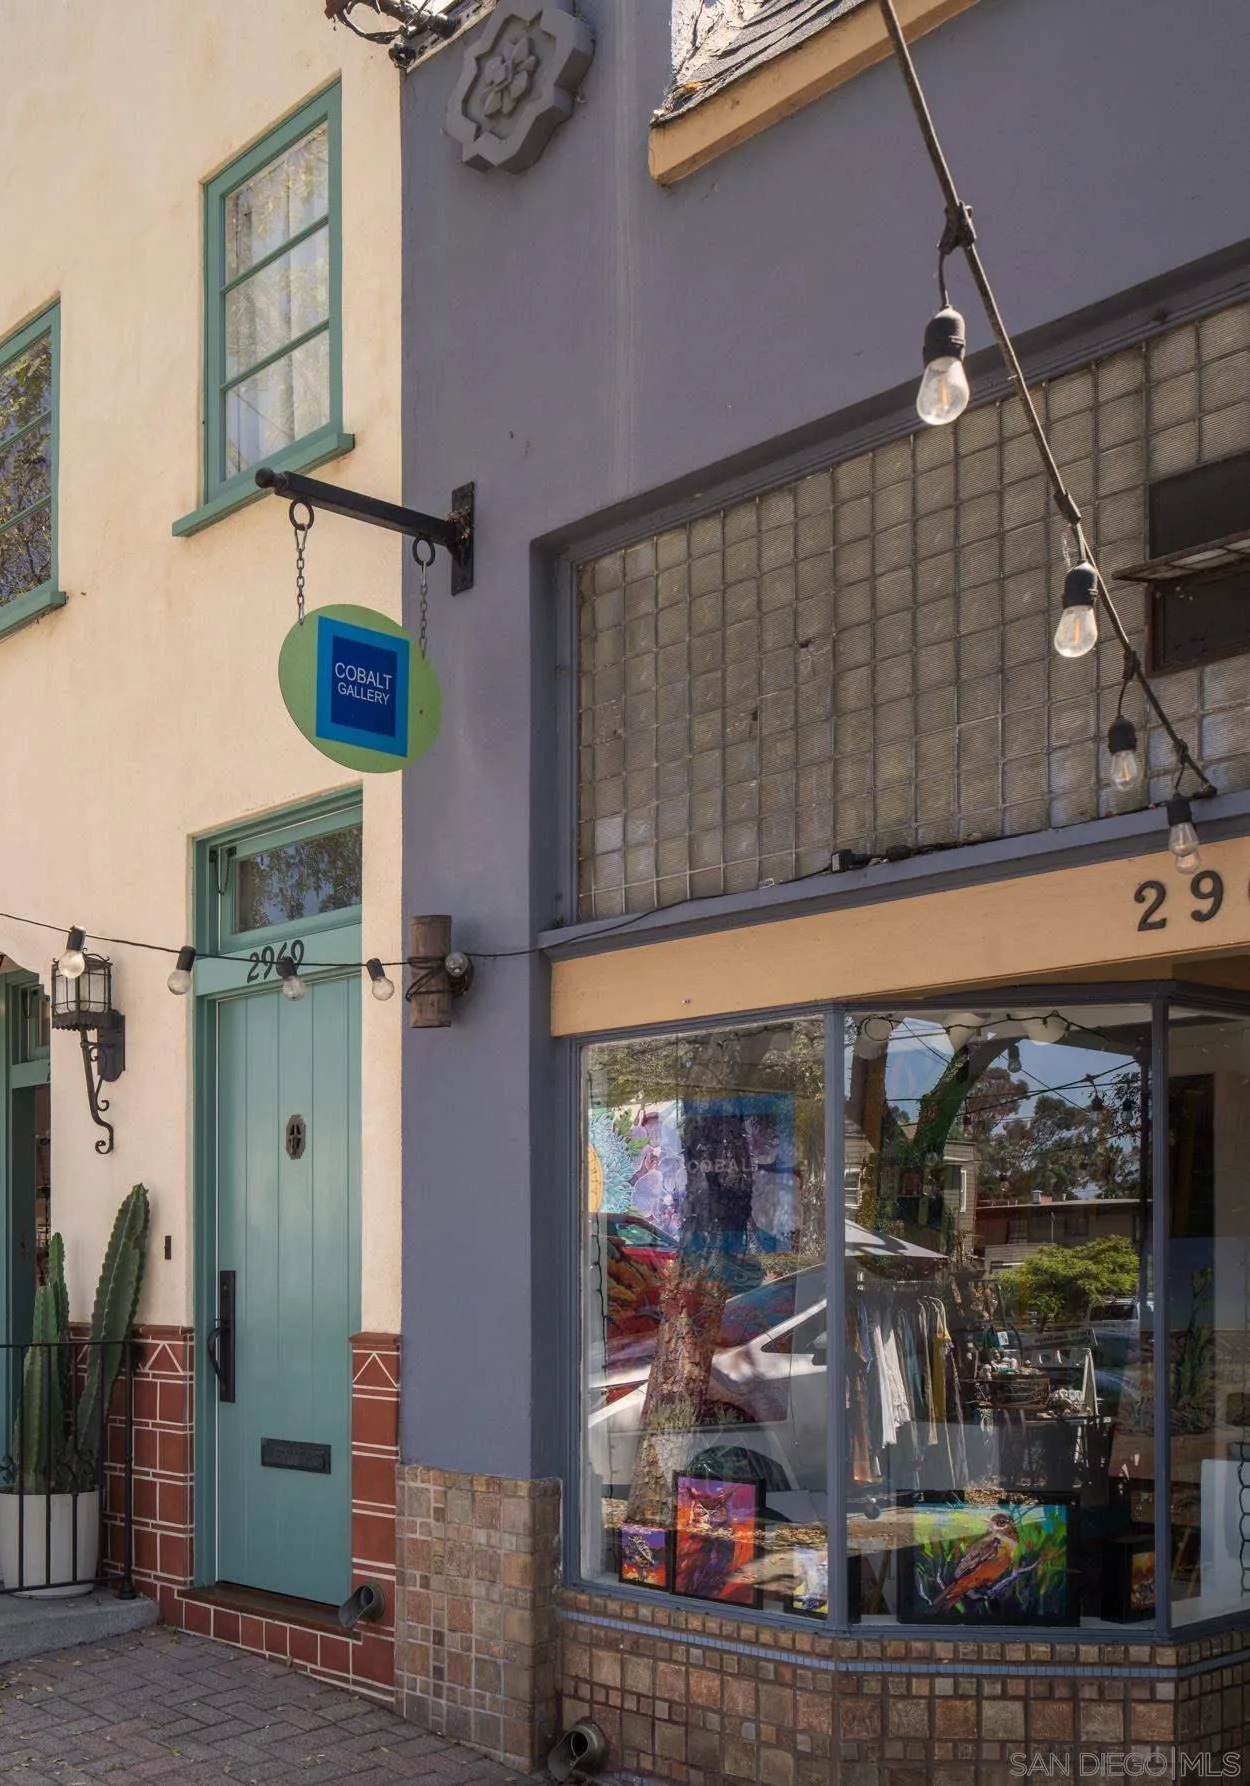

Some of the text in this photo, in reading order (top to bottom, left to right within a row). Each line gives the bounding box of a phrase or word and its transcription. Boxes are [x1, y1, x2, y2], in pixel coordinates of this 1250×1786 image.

[335, 662, 393, 690] COBALT
[337, 682, 391, 705] GALLERY
[1134, 869, 1250, 932] 29
